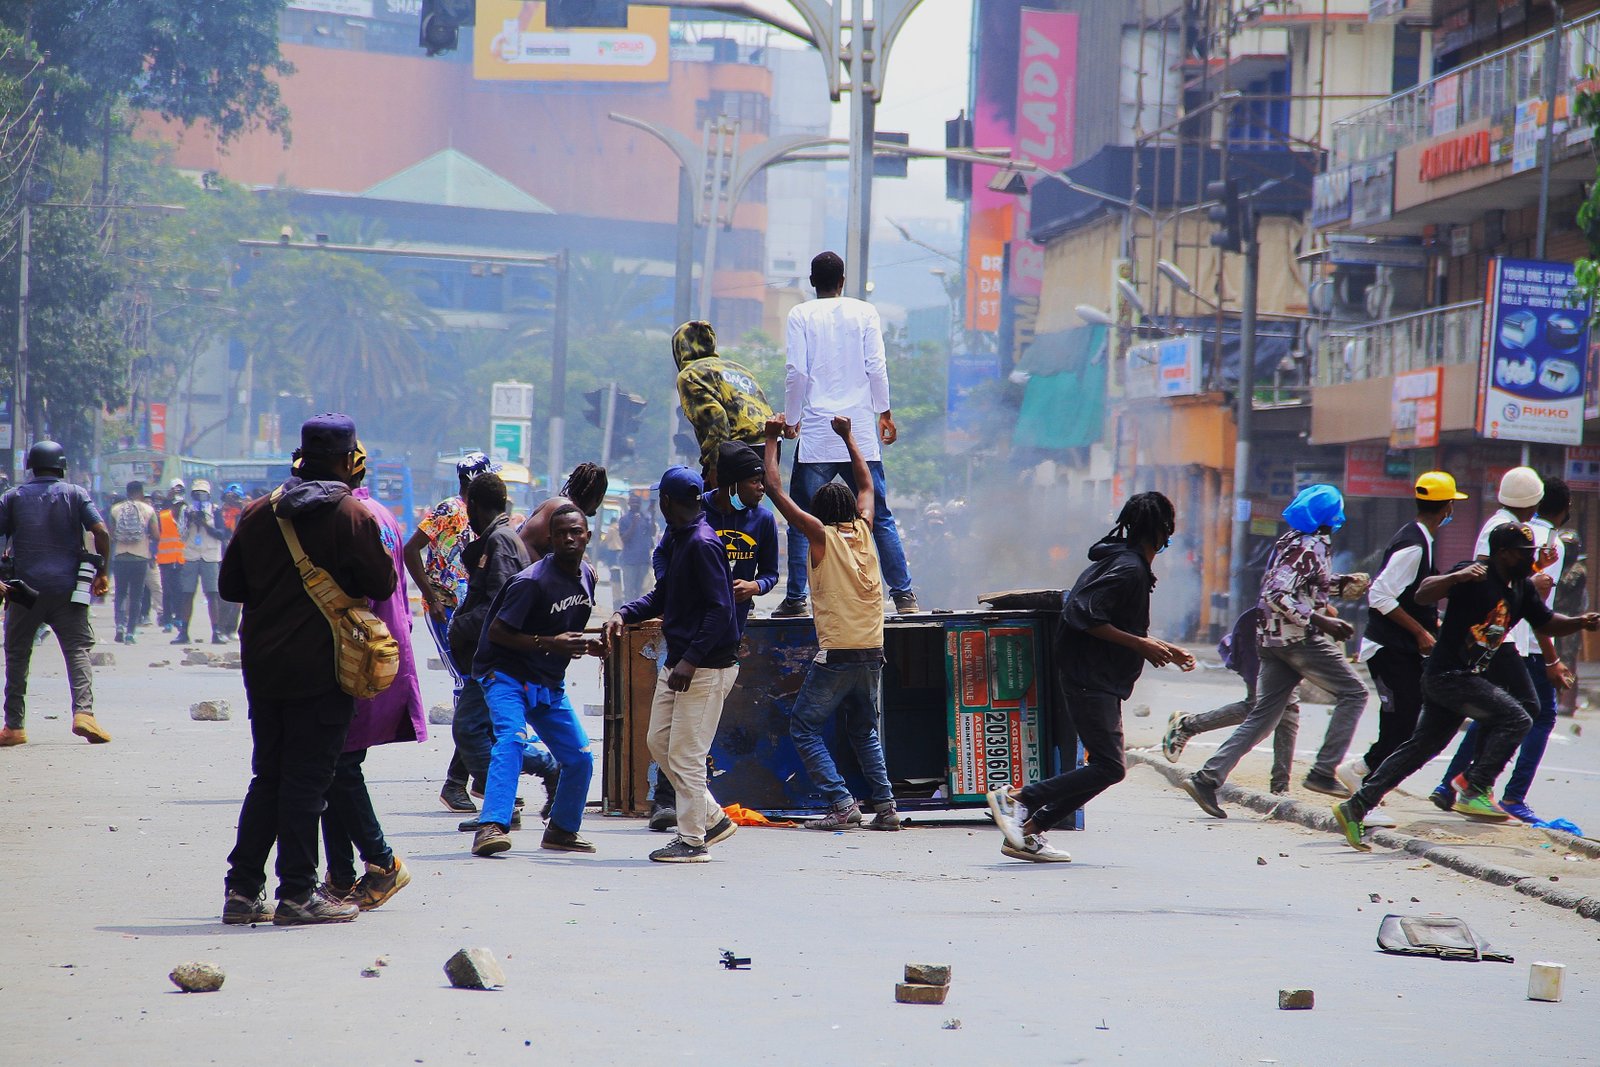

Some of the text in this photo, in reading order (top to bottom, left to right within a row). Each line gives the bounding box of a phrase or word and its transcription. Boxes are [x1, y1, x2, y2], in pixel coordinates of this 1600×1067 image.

[1017, 27, 1060, 281] BTLADY
[1503, 267, 1525, 281] YOUR
[1526, 268, 1543, 282] ONE
[1544, 269, 1566, 284] STOP
[1502, 281, 1517, 294] FOR
[1517, 282, 1549, 296] THERMAL
[1501, 294, 1522, 305] ROLLS
[1522, 406, 1569, 419] RIKKO
[727, 551, 755, 560] NVILLE
[964, 637, 974, 701] LINES AVAILABLE
[975, 715, 985, 792] AGENT NAME
[1011, 719, 1021, 786] AGENT NO.
[958, 780, 963, 789] ID
